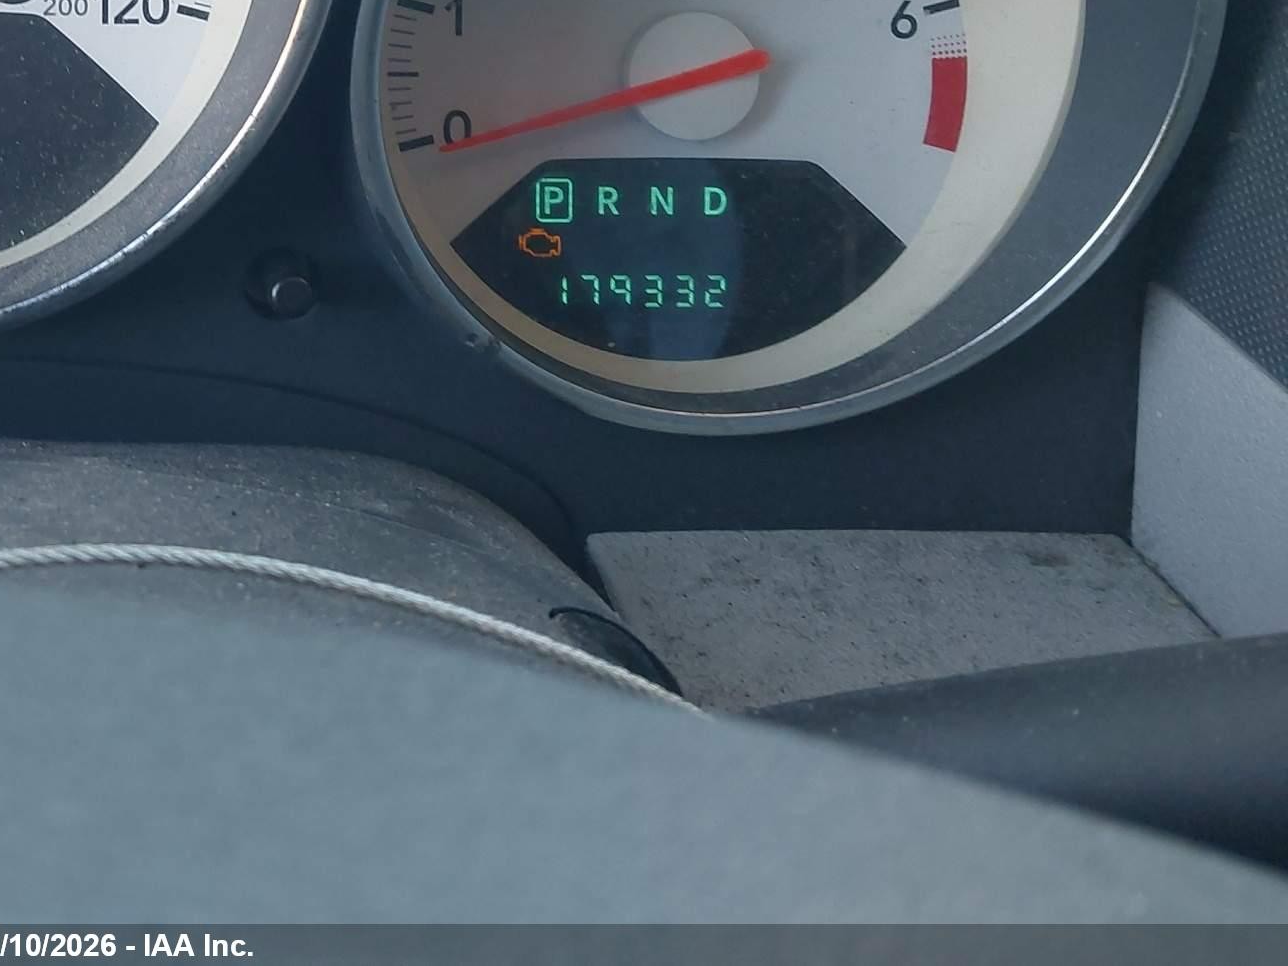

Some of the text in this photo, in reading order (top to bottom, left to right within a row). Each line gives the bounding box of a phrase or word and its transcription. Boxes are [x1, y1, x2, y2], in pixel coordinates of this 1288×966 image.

[445, 0, 463, 35] 1
[891, 0, 918, 39] 6
[443, 110, 472, 147] 0
[544, 186, 727, 215] P R N D
[561, 274, 727, 307] 179332
